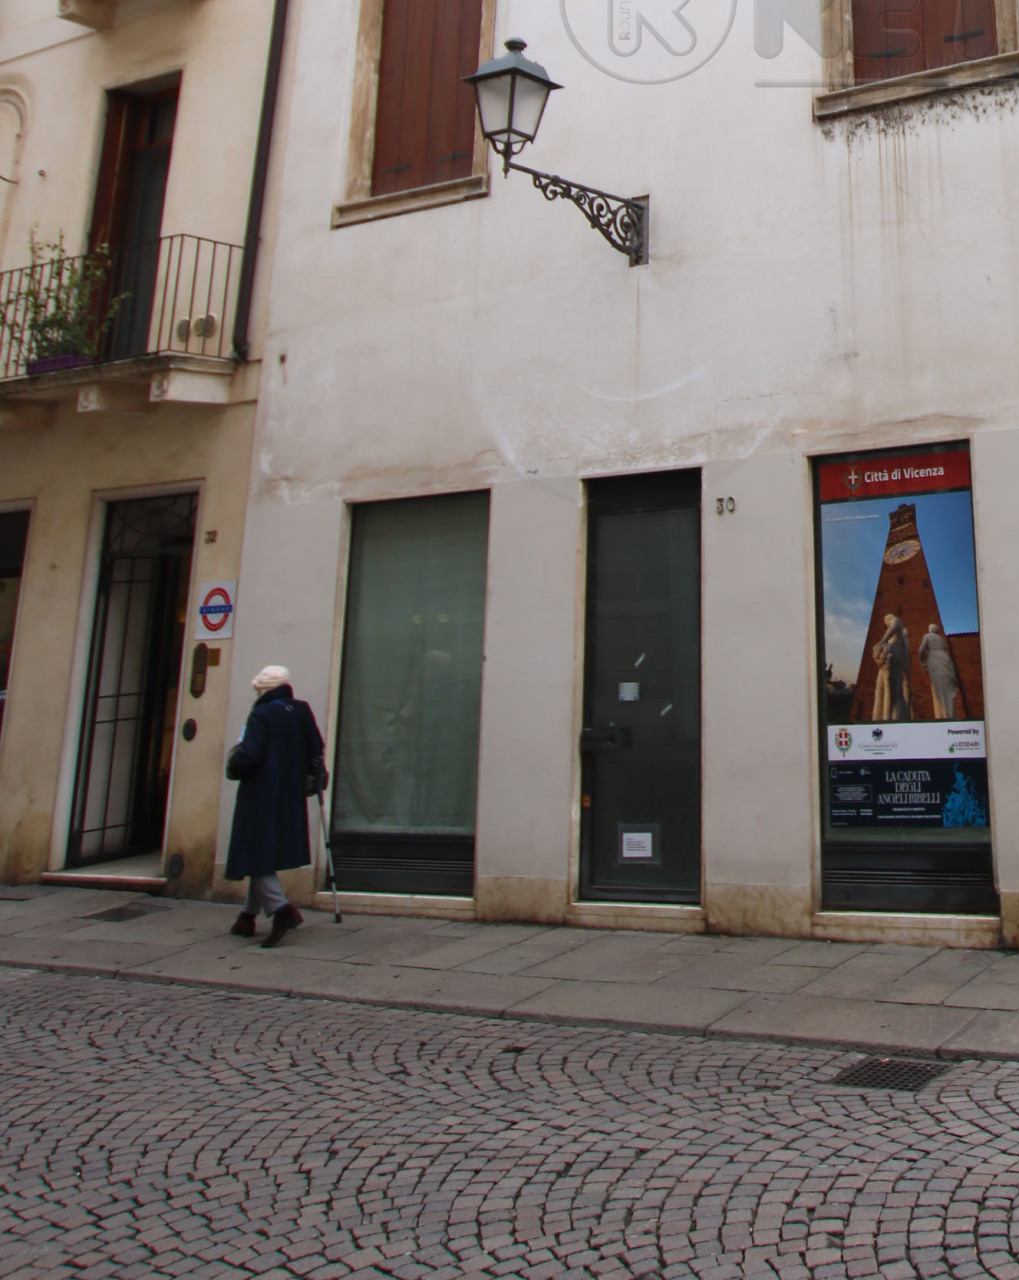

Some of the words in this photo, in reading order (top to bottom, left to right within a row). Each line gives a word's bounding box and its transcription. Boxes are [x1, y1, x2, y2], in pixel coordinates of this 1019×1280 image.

[864, 469, 889, 483] Città
[891, 468, 901, 480] di
[903, 466, 945, 479] Vicenza
[716, 496, 736, 515] 30
[947, 728, 971, 736] Powered
[972, 728, 980, 736] by
[885, 771, 896, 782] LA
[897, 770, 931, 782] CADUTA
[895, 782, 922, 793] DEGLI
[877, 793, 908, 804] ANGELI
[909, 792, 941, 804] RIBELLI
